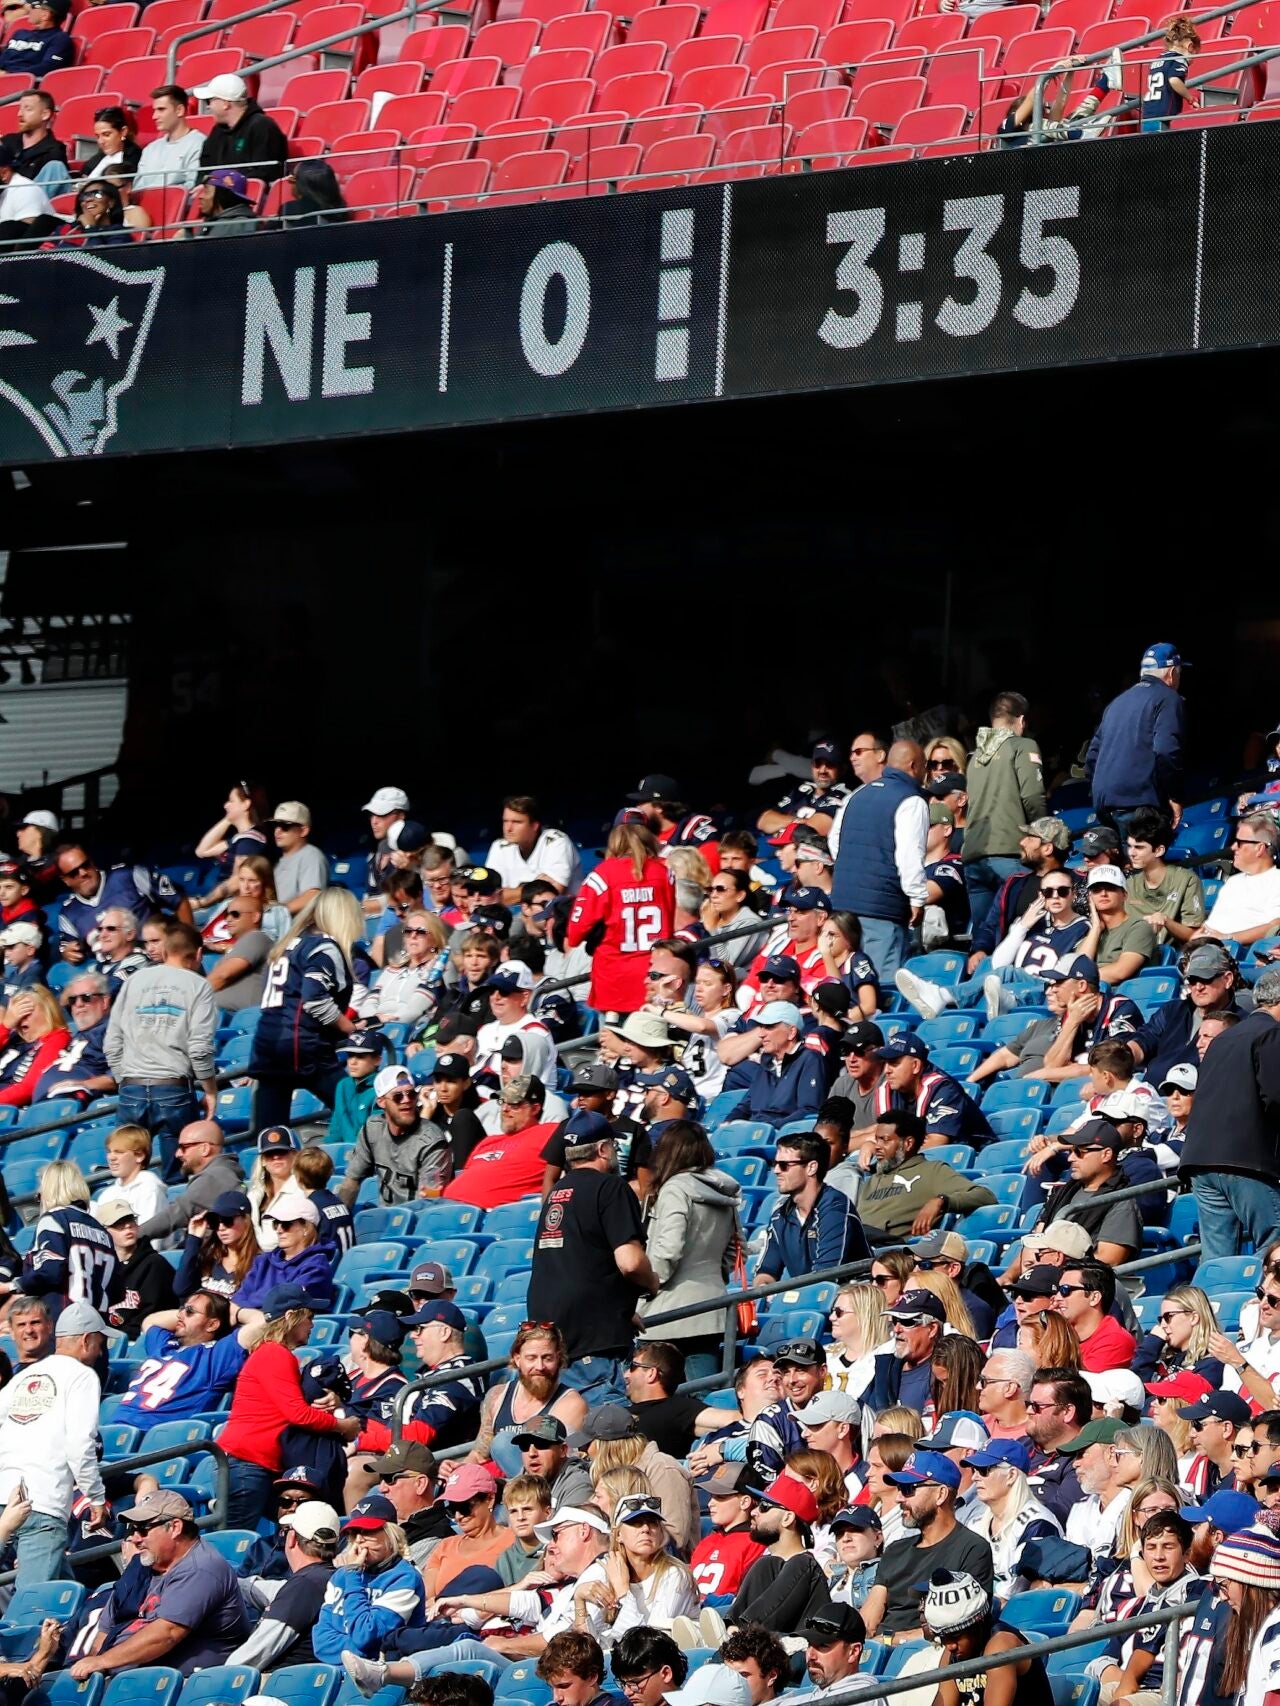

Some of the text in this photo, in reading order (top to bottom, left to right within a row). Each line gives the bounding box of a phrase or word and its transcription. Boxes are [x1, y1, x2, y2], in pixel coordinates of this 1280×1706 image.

[520, 242, 590, 377] 0
[817, 185, 1080, 349] 3:35
[241, 259, 379, 406] NE
[620, 906, 662, 953] 12
[621, 887, 653, 904] BRADY
[68, 1245, 115, 1313] 87
